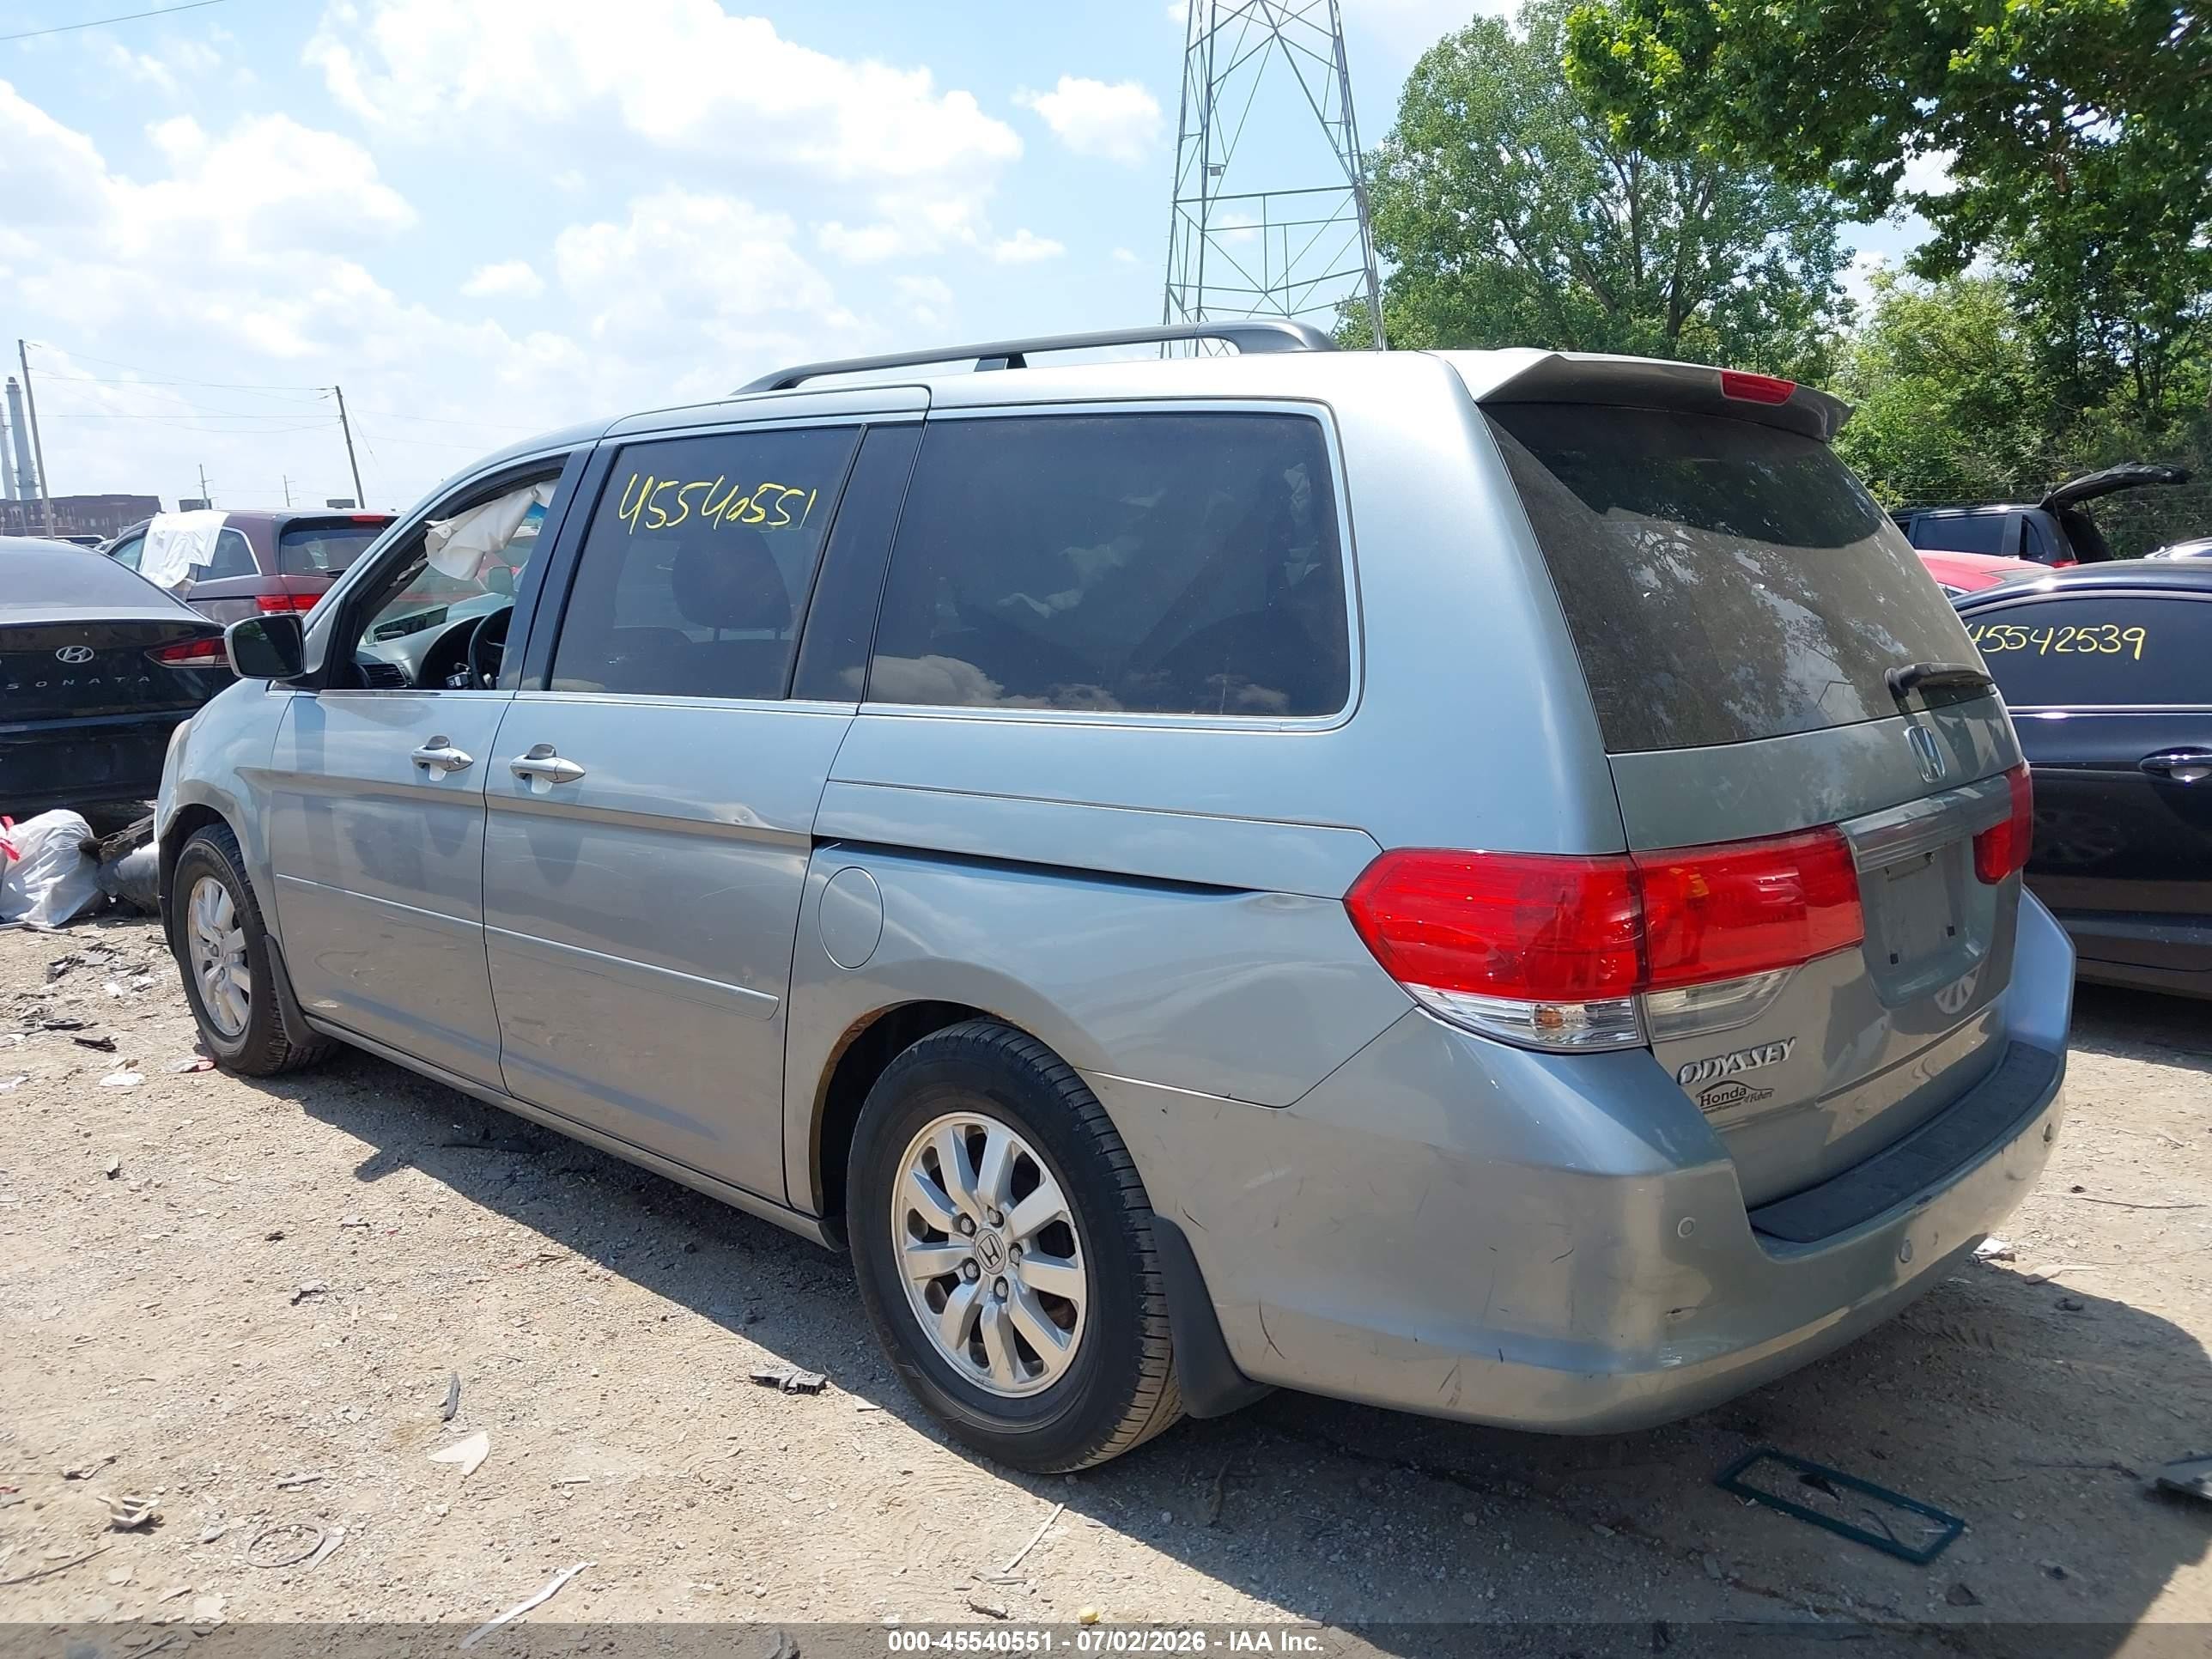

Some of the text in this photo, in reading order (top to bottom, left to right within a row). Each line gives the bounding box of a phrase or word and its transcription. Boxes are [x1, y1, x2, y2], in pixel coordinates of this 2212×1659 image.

[619, 473, 817, 535] 45540551
[6, 675, 151, 690] SONATA
[1677, 1036, 1796, 1085] ODYSSEY
[1699, 1086, 1747, 1108] Honda
